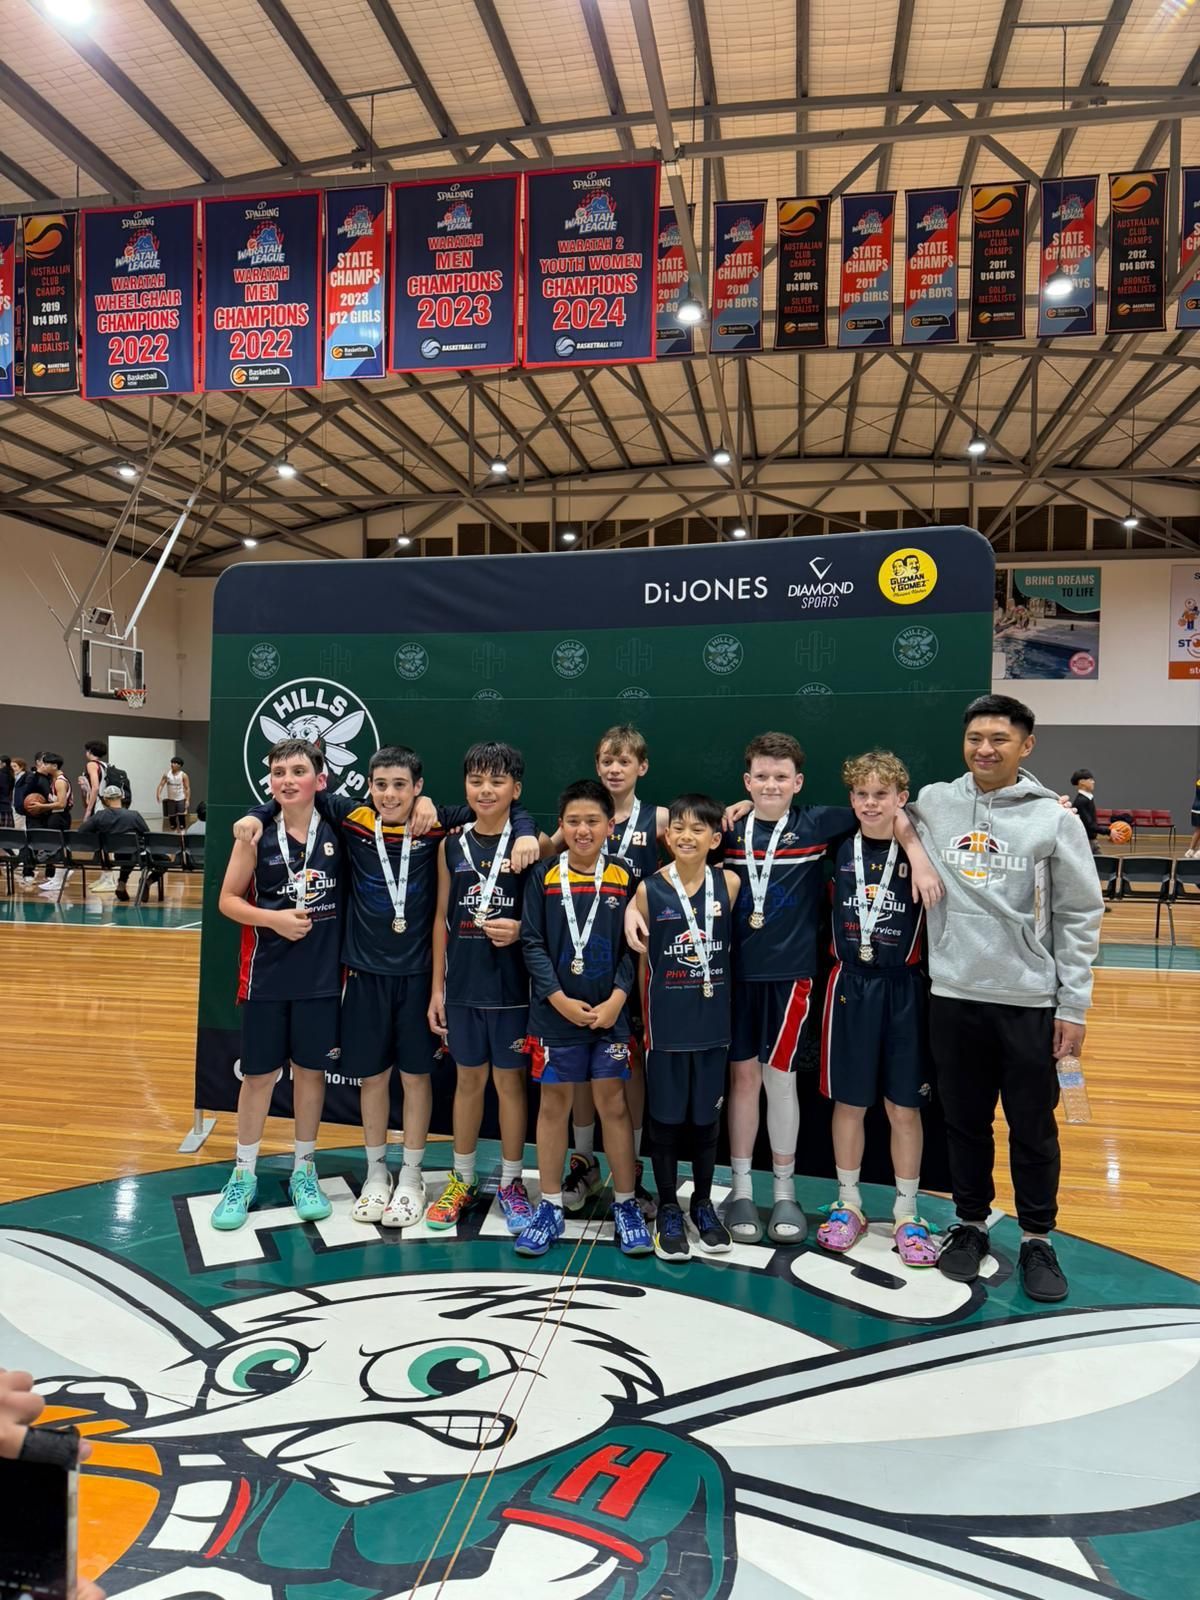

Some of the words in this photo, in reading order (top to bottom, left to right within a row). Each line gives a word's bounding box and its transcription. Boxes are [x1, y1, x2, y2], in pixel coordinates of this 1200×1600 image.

[573, 178, 611, 190] SPALDING
[437, 190, 474, 202] SPALDING
[245, 207, 279, 220] SPALDING
[122, 217, 155, 229] SPALDING
[447, 222, 473, 232] LEAGUE
[565, 213, 615, 231] WARATAH
[579, 221, 618, 234] LEAGUE
[1117, 217, 1160, 228] AUSTRALIAN
[347, 228, 374, 238] LEAGUE
[979, 229, 1020, 238] AUSTRALIAN
[1129, 228, 1147, 236] CLUB
[428, 234, 484, 251] WARATAH
[990, 239, 1008, 247] CLUB
[1053, 231, 1084, 246] STATE
[1124, 236, 1153, 246] CHAMPS
[558, 238, 612, 254] WARATAH
[615, 237, 625, 251] 2
[784, 241, 823, 251] AUSTRALIAN
[917, 241, 948, 255] STATE
[985, 246, 1013, 256] CHAMPS
[238, 245, 282, 261] WARATAH
[251, 252, 285, 265] LEAGUE
[795, 251, 812, 259] CLUB
[852, 246, 882, 259] STATE
[1046, 246, 1091, 261] CHAMPS
[1128, 250, 1147, 259] 2012
[116, 252, 158, 267] WARATAH
[128, 259, 161, 272] LEAGUE
[338, 251, 373, 269] STATE
[436, 251, 473, 270] MEN
[540, 257, 585, 274] YOUTH
[589, 253, 643, 270] WOMEN
[657, 257, 683, 272] STATE
[724, 252, 753, 267] STATE
[789, 259, 817, 268] CHAMPS
[911, 255, 953, 270] CHAMPS
[990, 261, 1007, 269] 2011
[31, 265, 71, 276] AUSTRALIAN
[846, 259, 889, 273] CHAMPS
[1120, 262, 1134, 271] U14
[1135, 261, 1155, 270] BOYS
[234, 266, 290, 284] WARATAH
[330, 269, 381, 287] CHAMPS
[658, 271, 689, 284] HAMPS
[718, 266, 759, 280] CHAMPS
[794, 272, 811, 281] 2010
[981, 272, 995, 281] U14
[996, 271, 1015, 280] BOYS
[42, 276, 59, 286] CLUB
[112, 274, 166, 291] WARATAH
[408, 270, 503, 297] CHAMPIONS
[856, 278, 877, 289] 2011
[921, 274, 943, 285] 2011
[1124, 276, 1151, 285] BRONZE
[36, 287, 65, 297] CHAMPS
[542, 274, 638, 299] CHAMPIONS
[727, 284, 750, 296] 2010
[786, 283, 799, 291] U14
[800, 282, 819, 291] BOYS
[989, 286, 1007, 294] GOLD
[1118, 285, 1157, 294] MEDALISTS
[245, 283, 279, 303] MEN
[658, 289, 680, 300] 2010
[844, 293, 861, 303] U16
[863, 291, 889, 302] GIRLS
[910, 289, 927, 300] U14
[929, 288, 953, 298] BOYS
[979, 294, 1017, 304] MEDALISTS
[95, 291, 182, 311] WHEELCHAIR
[340, 293, 369, 306] 2023
[717, 298, 733, 309] U14
[735, 297, 759, 308] BOYS
[792, 297, 813, 306] SILVER
[41, 302, 60, 312] 2019
[417, 295, 492, 329] 2023
[784, 305, 820, 314] MEDALISTS
[33, 316, 47, 326] U14
[49, 314, 68, 325] BOYS
[215, 303, 309, 330] CHAMPIONS
[330, 311, 348, 325] U12
[351, 310, 381, 324] GIRLS
[553, 298, 626, 330] 2024
[97, 311, 180, 334] CHAMPIONS
[42, 333, 60, 342] GOLD
[32, 342, 70, 353] MEDALISTS
[109, 334, 170, 365] 2022
[230, 329, 293, 360] 2022
[442, 343, 474, 352] BASKETBALL
[576, 342, 609, 350] BASKETBALL
[127, 373, 158, 382] Basketball
[249, 368, 280, 377] Basketball
[890, 573, 925, 586] GUZMAN
[1025, 576, 1055, 586] BRING
[1057, 575, 1095, 585] DREAMS
[644, 576, 768, 604] DiJONES
[788, 581, 854, 597] DIAMOND
[898, 580, 927, 592] GOMEZ
[1062, 587, 1073, 597] TO
[1076, 587, 1095, 597] LIFE
[801, 596, 840, 609] SPORTS
[903, 629, 929, 639] HILLS
[560, 641, 581, 650] HILLS
[711, 637, 734, 647] HILLS
[254, 645, 273, 654] HILLS
[402, 645, 421, 654] HILLS
[898, 651, 934, 667] HORNETS
[252, 665, 277, 677] HORNETS
[399, 665, 425, 677] HORNETS
[556, 663, 585, 676] HORNETS
[707, 658, 740, 673] HORNETS
[272, 688, 349, 720] HILLS
[632, 831, 648, 847] 21
[323, 842, 335, 857] 6
[500, 858, 512, 873] 2
[277, 878, 337, 895] JOLOW
[458, 895, 515, 907] JOFOW
[713, 901, 723, 917] 2
[666, 970, 688, 979] PHW
[552, 1445, 669, 1518] H
